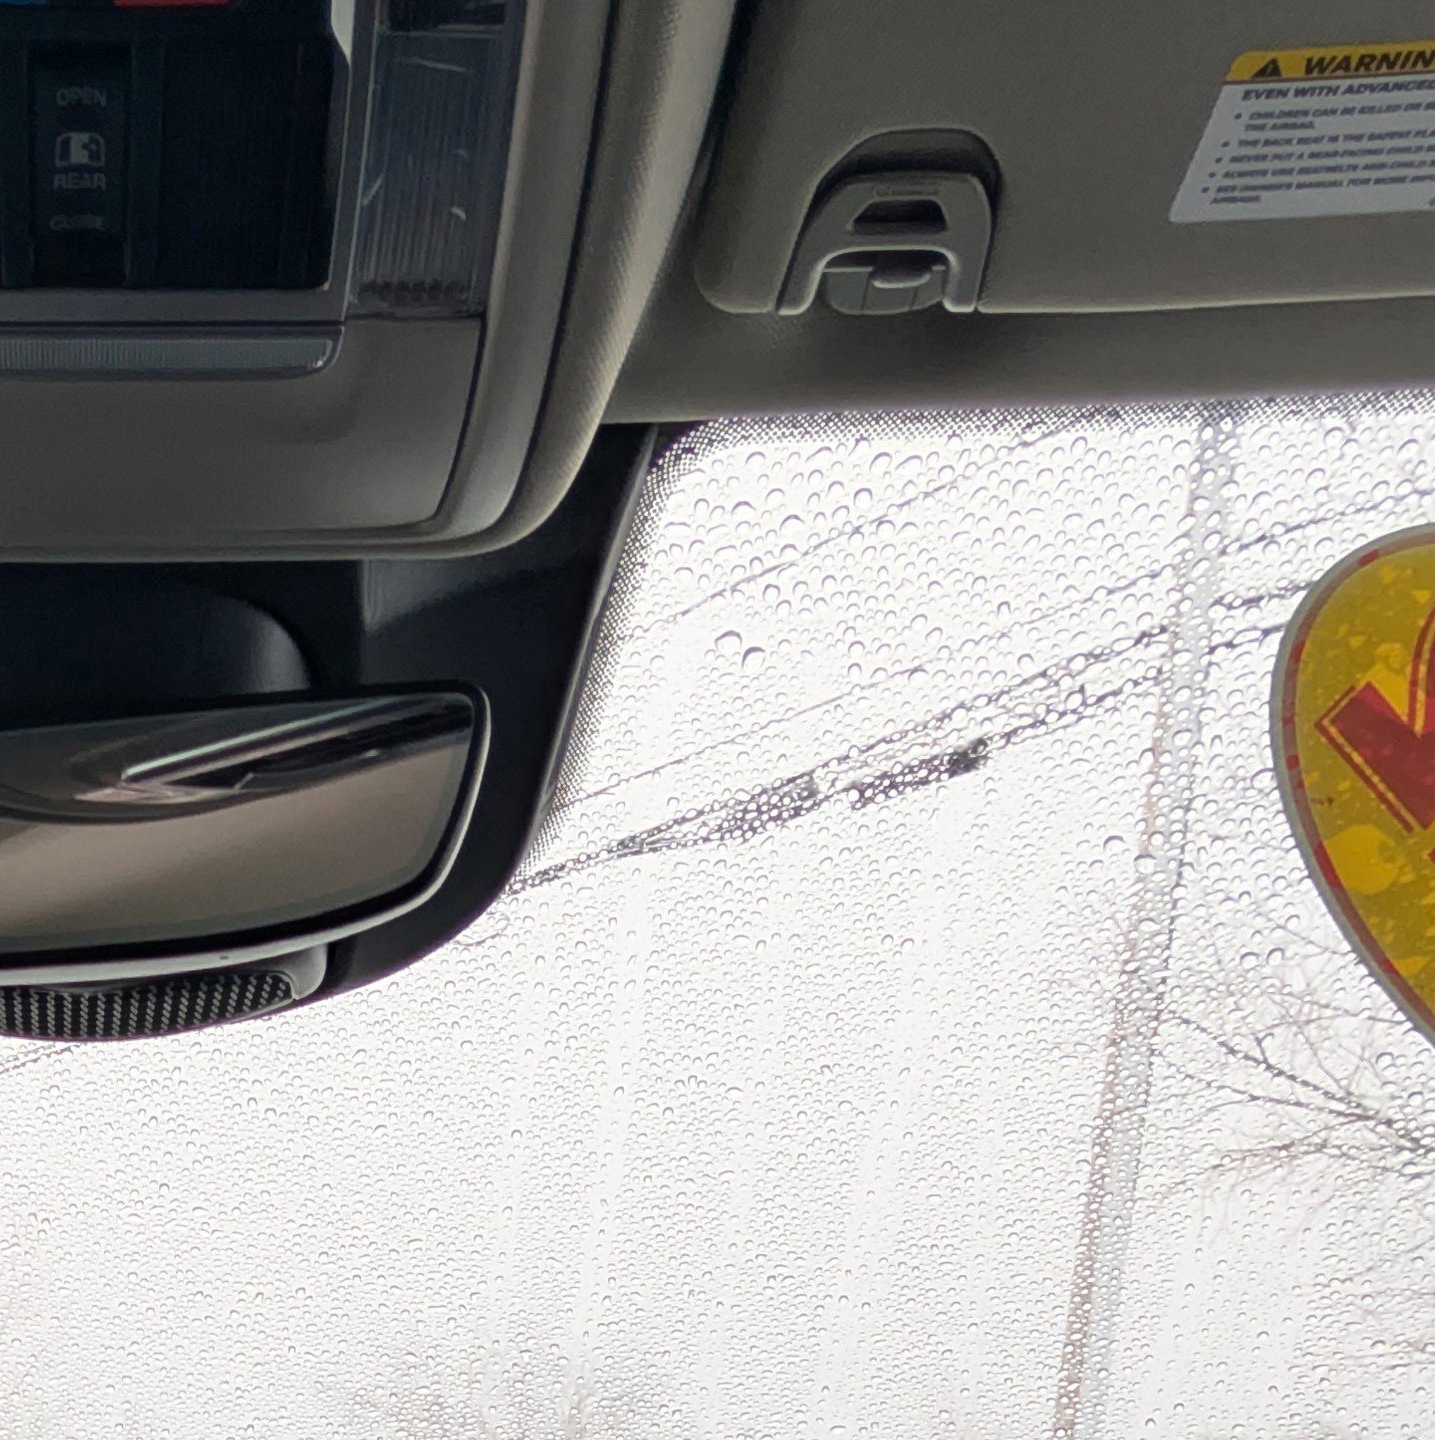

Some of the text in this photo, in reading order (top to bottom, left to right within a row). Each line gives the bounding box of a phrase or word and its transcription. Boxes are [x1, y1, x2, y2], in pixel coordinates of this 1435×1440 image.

[1241, 87, 1291, 101] EVEN
[1294, 84, 1341, 98] WITH
[53, 172, 107, 192] REAR
